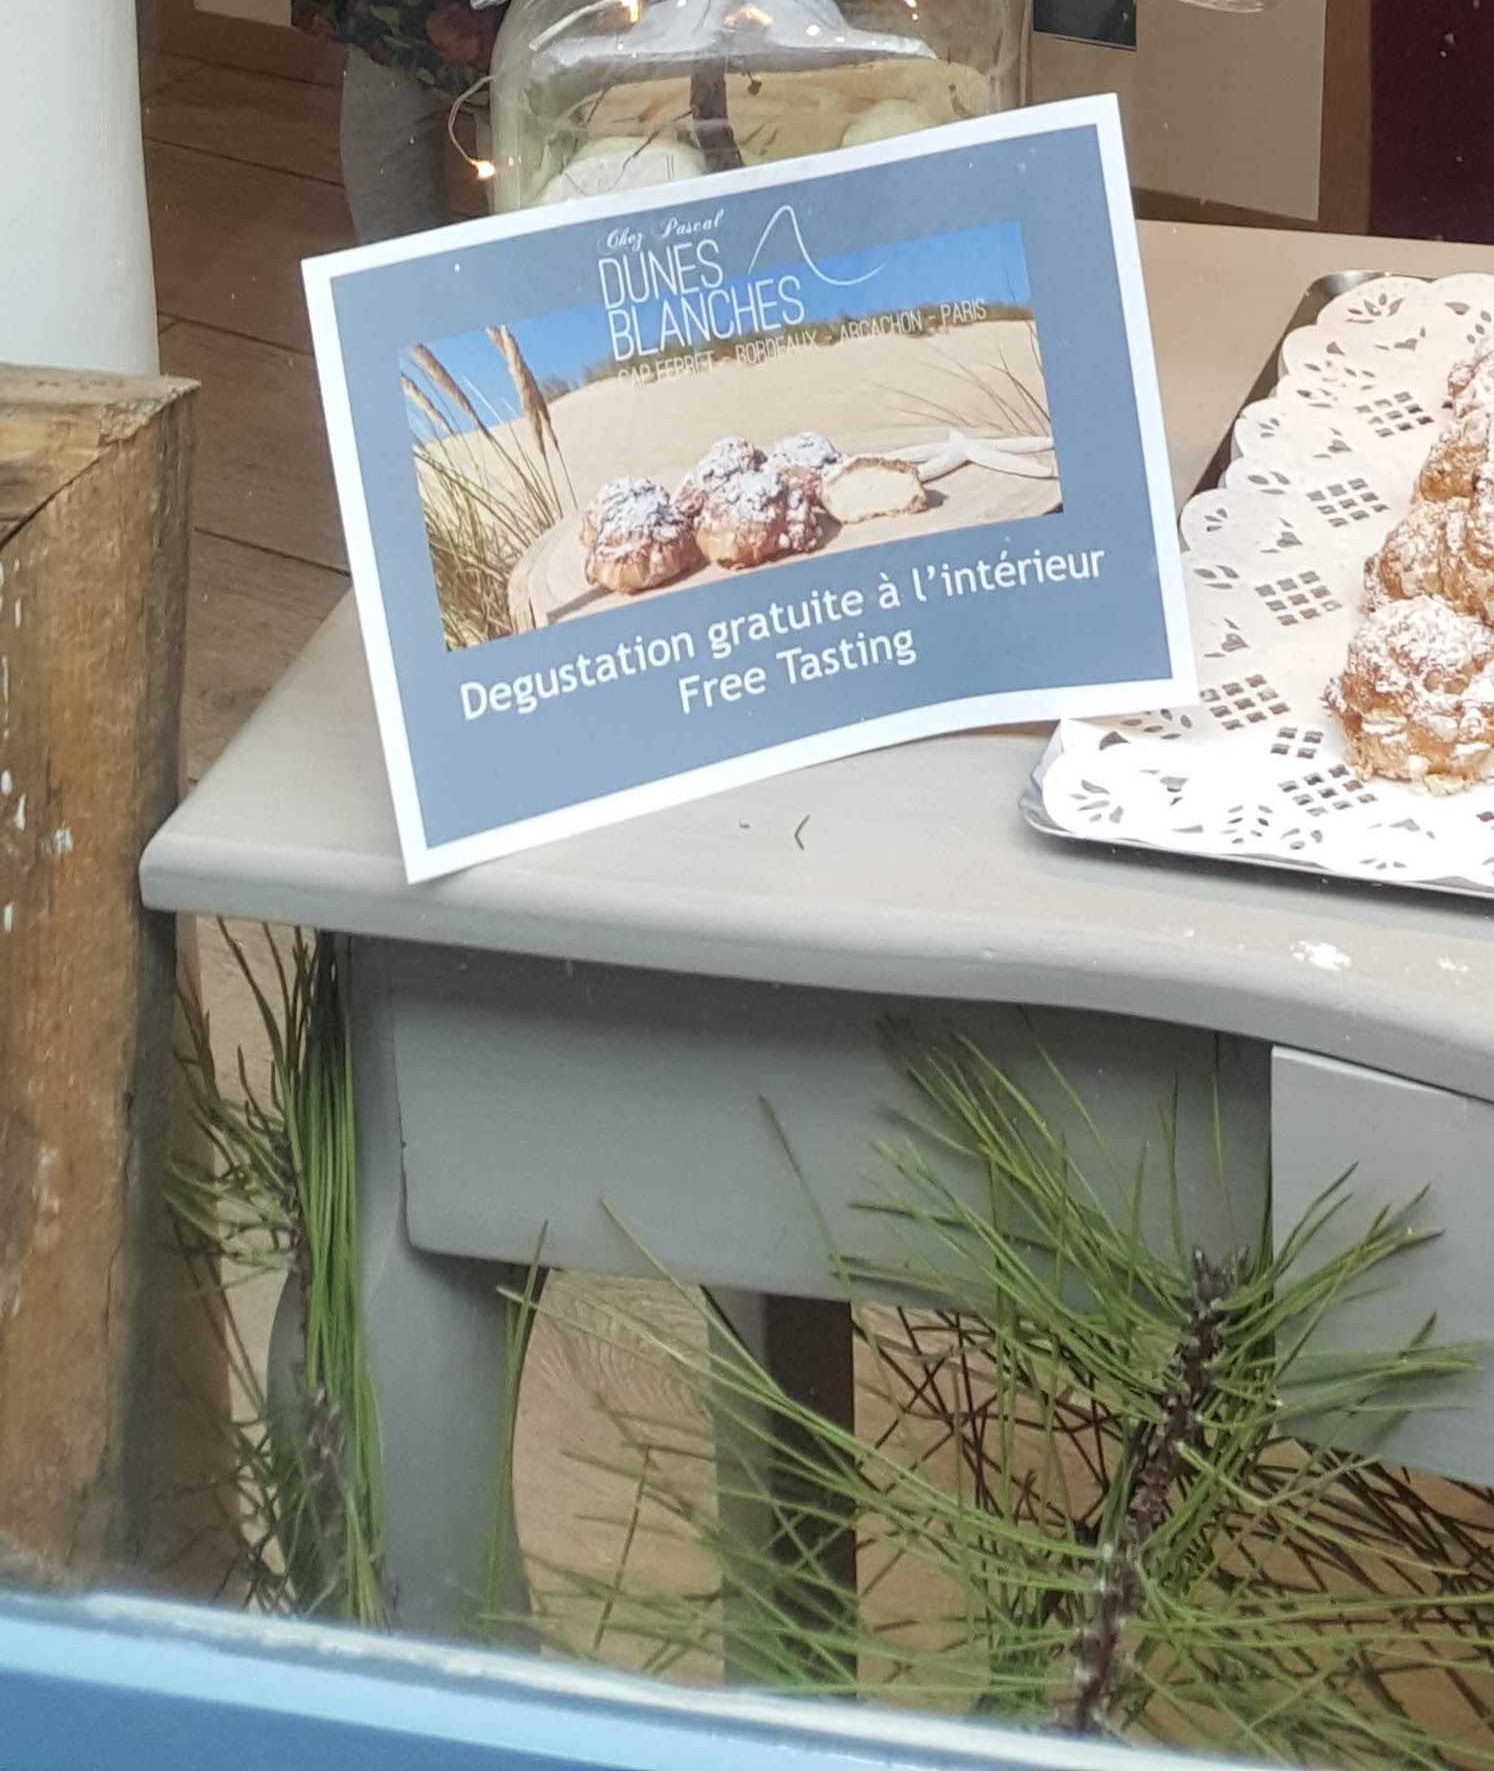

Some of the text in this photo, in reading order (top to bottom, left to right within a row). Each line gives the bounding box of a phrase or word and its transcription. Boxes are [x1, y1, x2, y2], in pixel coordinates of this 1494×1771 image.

[598, 238, 724, 310] DUNES
[600, 208, 725, 255] Chez Pascal
[607, 275, 805, 361] BLANCHES
[617, 366, 651, 389] CAP
[654, 350, 715, 382] FERRET
[734, 331, 820, 365] BORDEAUX
[839, 309, 922, 346] ARCACHON
[940, 298, 988, 327] PARIS
[459, 630, 696, 721] Degustation
[707, 587, 865, 659] gratuite
[878, 572, 902, 610] à
[678, 627, 918, 714] Free Tasting
